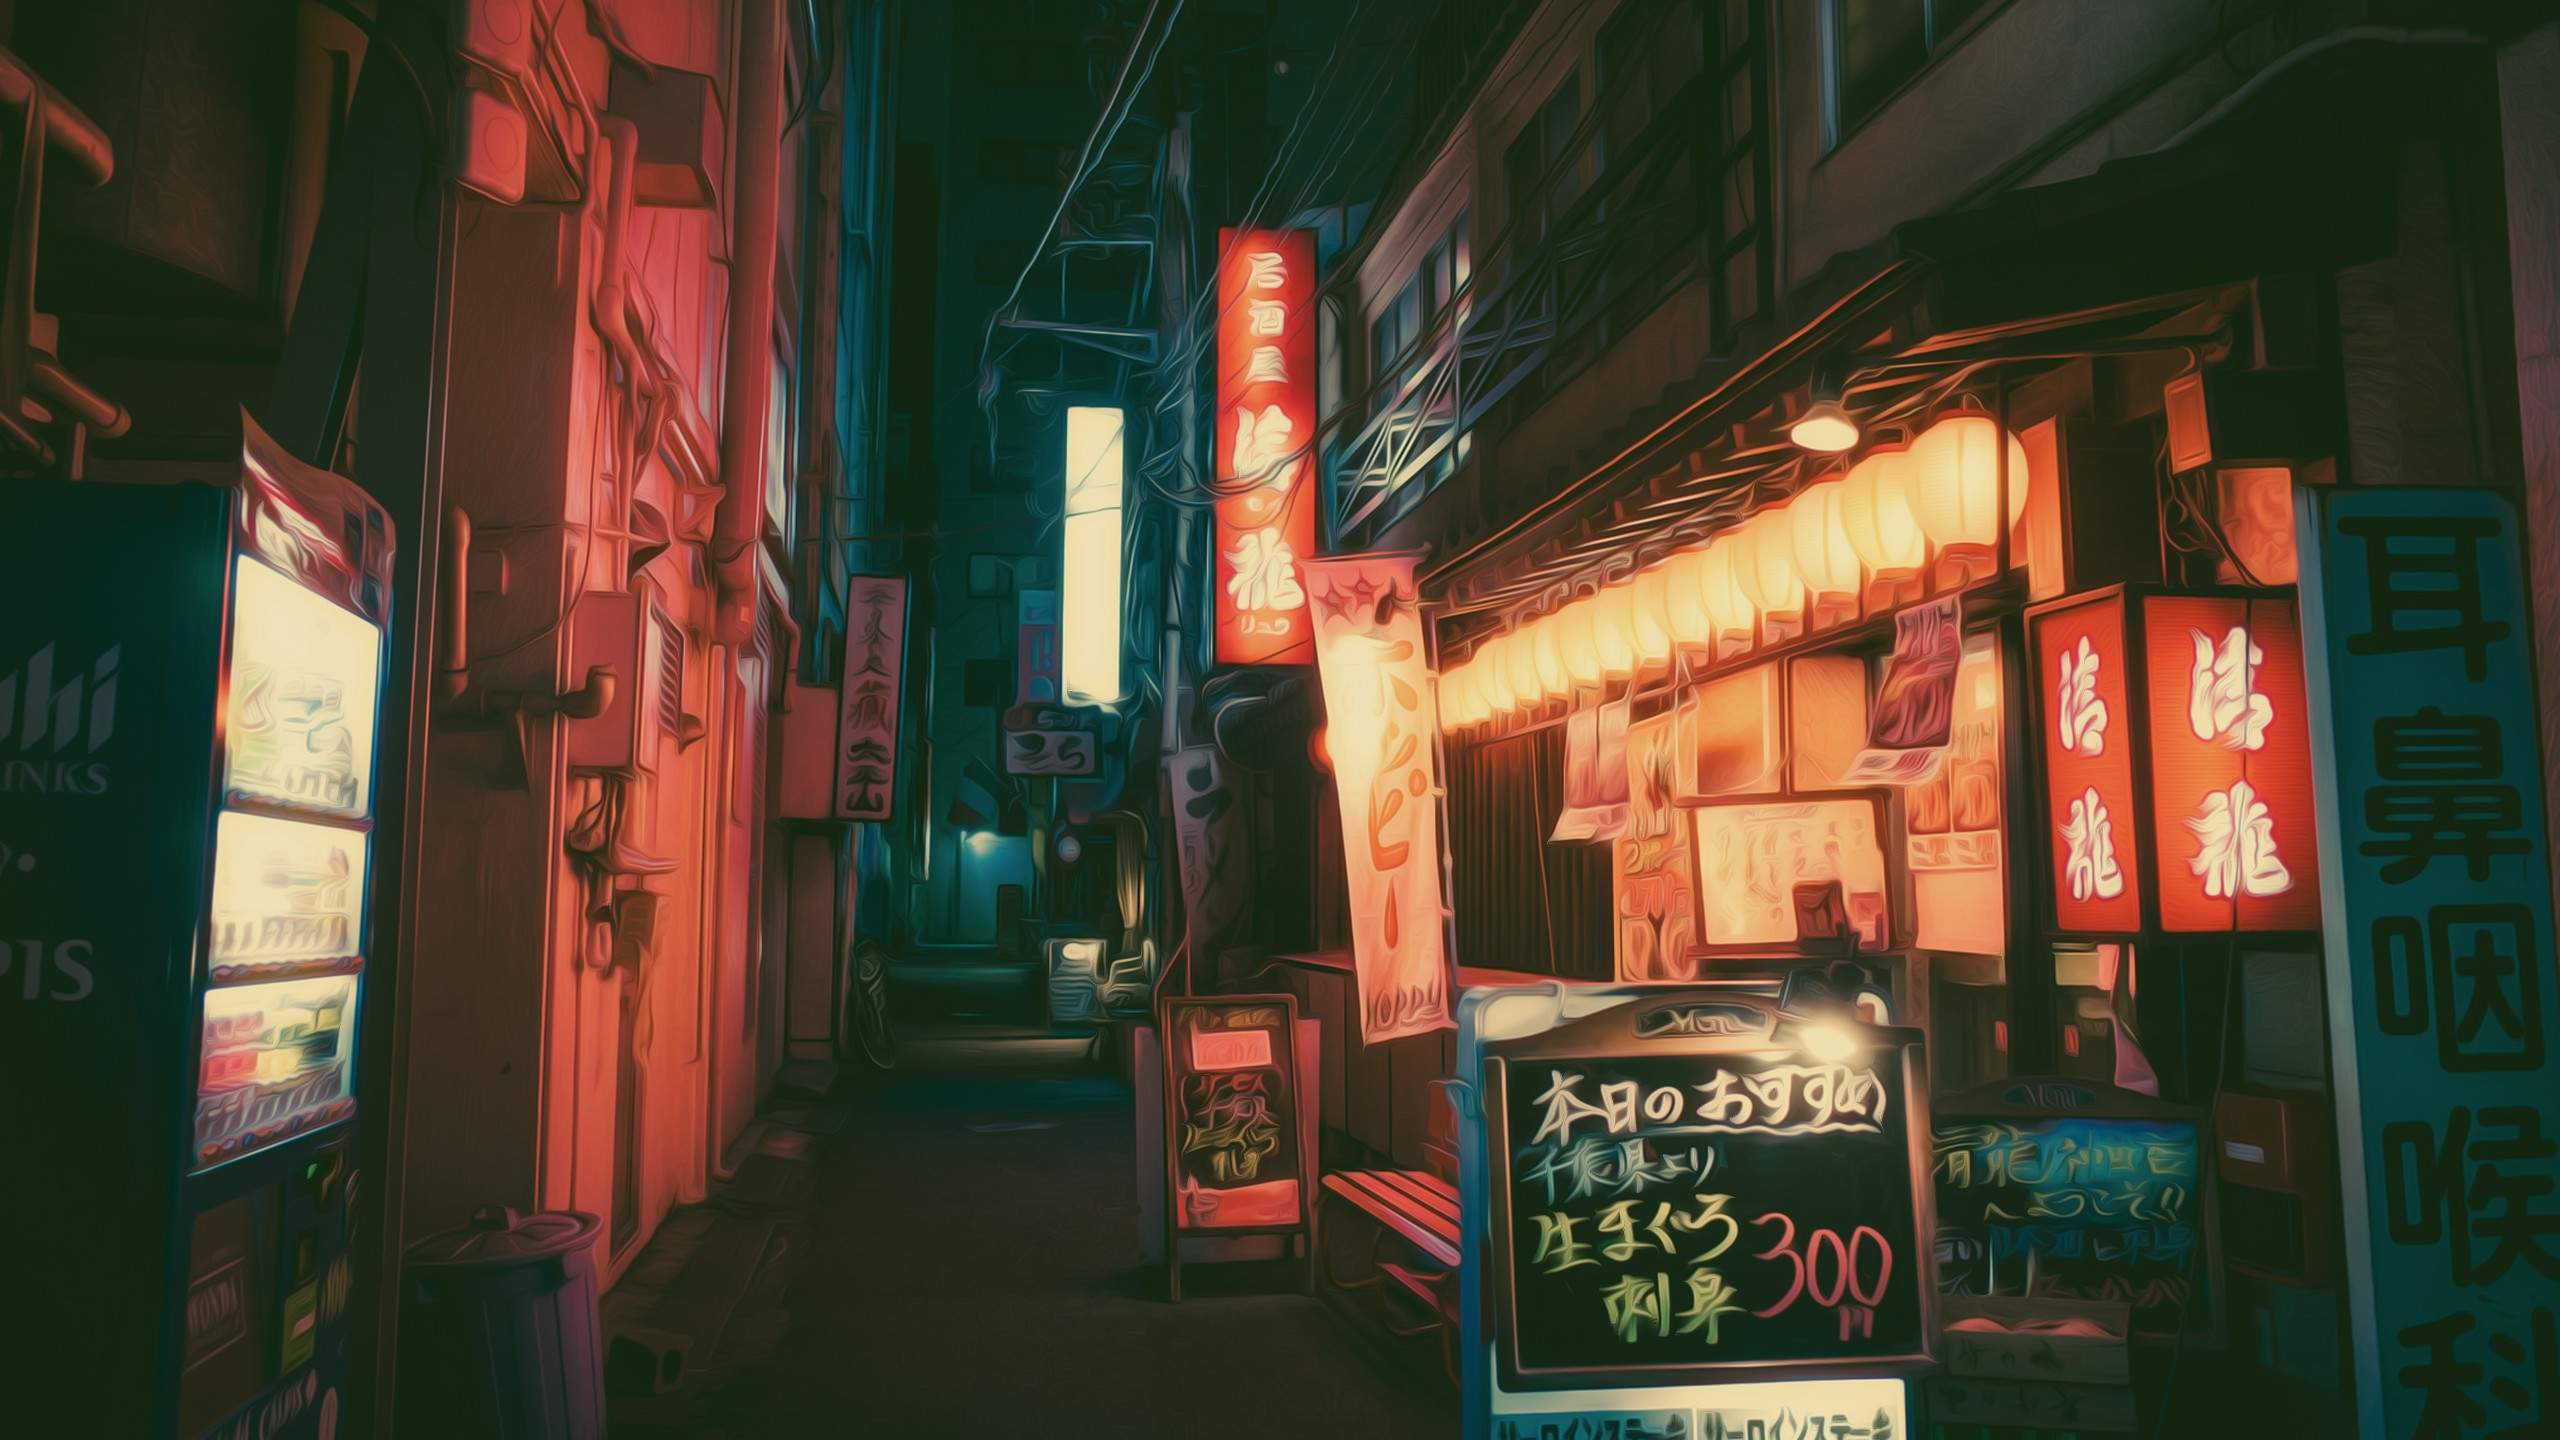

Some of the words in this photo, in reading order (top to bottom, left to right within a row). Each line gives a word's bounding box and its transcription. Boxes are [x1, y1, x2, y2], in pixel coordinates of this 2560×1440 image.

[2337, 515, 2560, 1440] 耳鼻咽喉科
[1749, 1212, 1893, 1318] 300
